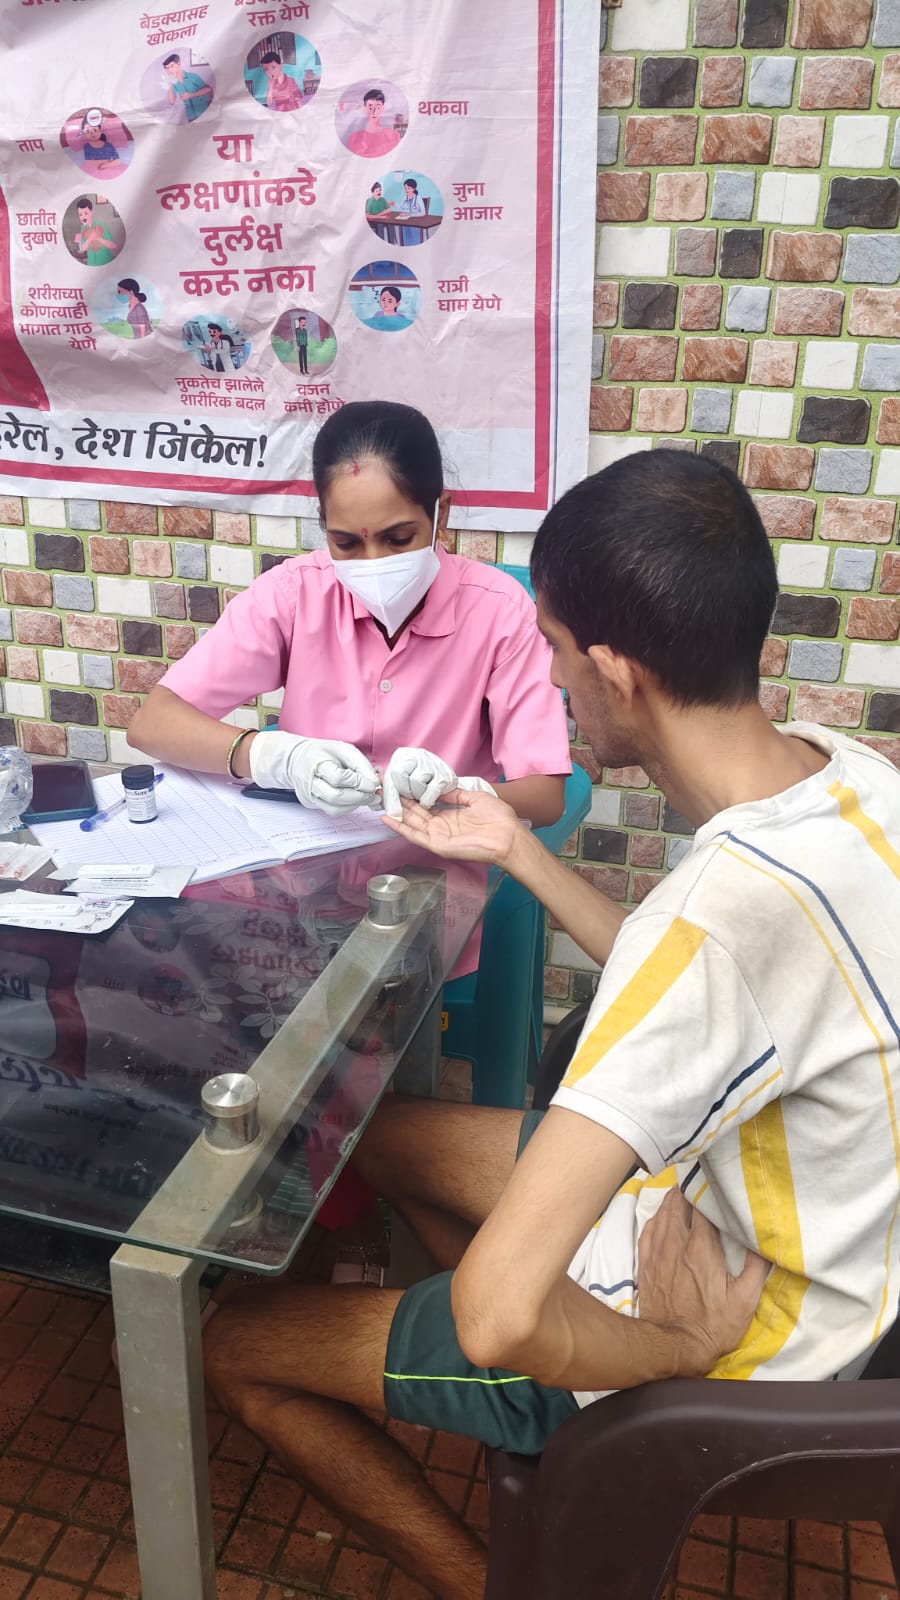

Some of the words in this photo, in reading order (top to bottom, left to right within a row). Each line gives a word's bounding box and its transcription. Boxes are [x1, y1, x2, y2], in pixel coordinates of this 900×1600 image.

[139, 4, 209, 29] बेडक्यासह
[247, 10, 276, 27] रक्त
[280, 1, 310, 21] येणे
[147, 24, 198, 46] खोकला
[418, 101, 469, 116] थकवा
[16, 138, 45, 153] ताप
[213, 134, 254, 163] या
[156, 168, 317, 212] लक्षणांकडे
[452, 182, 485, 202] जुना
[16, 208, 56, 226] छातीत
[453, 206, 503, 221] आजार
[22, 228, 58, 251] दुखणे
[200, 215, 283, 266] दुर्लक्ष
[244, 265, 316, 293] नका
[437, 275, 469, 294] रात्री
[28, 283, 84, 301] शरीराच्या
[20, 301, 88, 319] कोणत्याही
[437, 298, 468, 312] घाम
[472, 294, 502, 312] येणे
[19, 322, 61, 336] भागात
[63, 321, 93, 335] गाठ
[68, 335, 97, 351] येणे
[175, 375, 221, 392] नुकतेच
[224, 376, 265, 393] झालेले
[296, 384, 330, 396] वजन
[181, 391, 232, 408] शारीरिक
[235, 397, 266, 411] बदल
[284, 398, 313, 413] कमी
[0, 412, 64, 461] रेल,
[72, 417, 136, 460] देश
